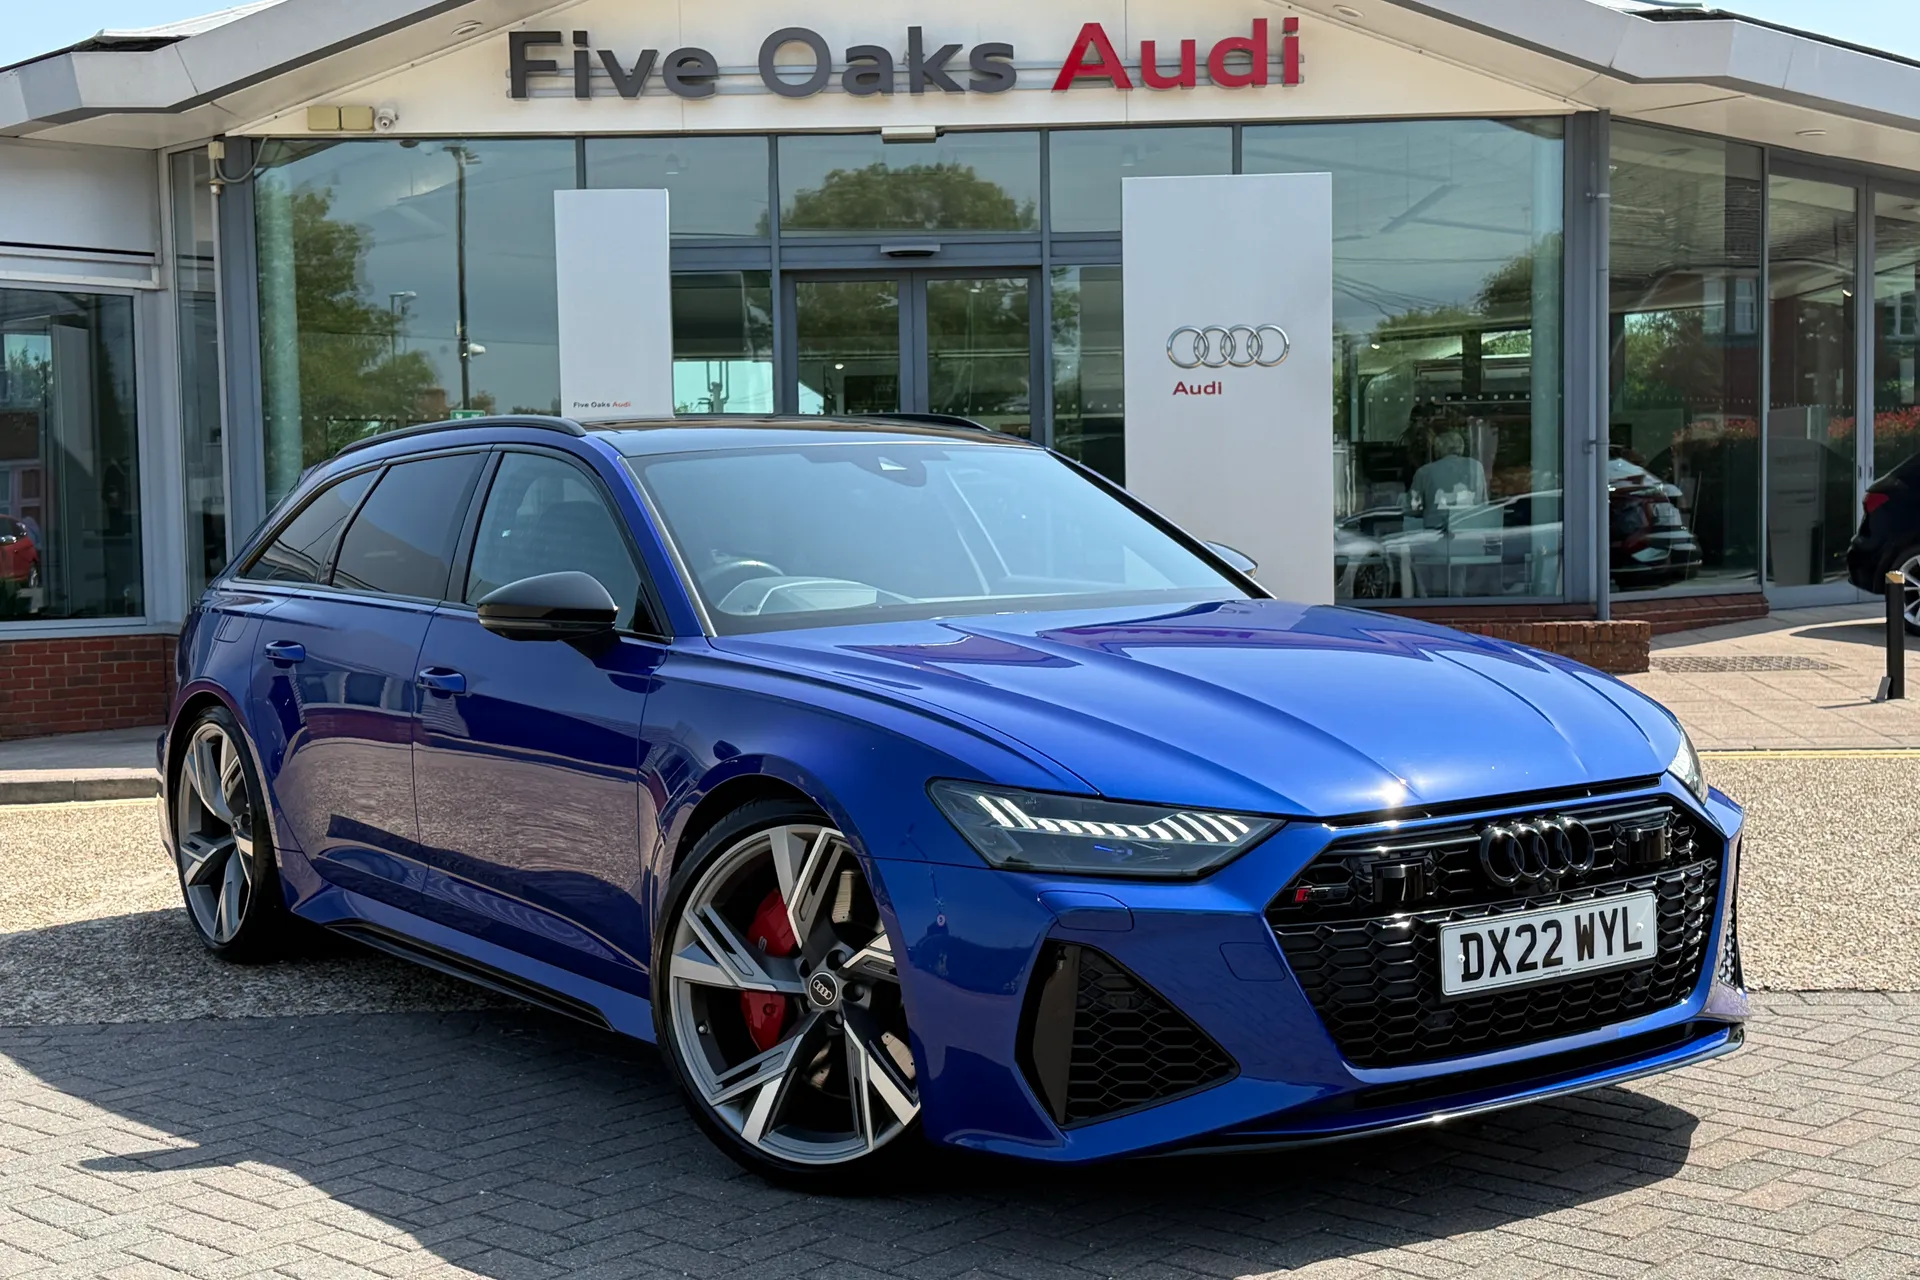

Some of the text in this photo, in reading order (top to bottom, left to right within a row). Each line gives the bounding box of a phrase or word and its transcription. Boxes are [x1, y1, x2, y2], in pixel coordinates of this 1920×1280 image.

[509, 17, 1299, 100] Five Oaks Audi
[1172, 380, 1222, 396] Audi
[1459, 906, 1643, 983] DX22 WYL
